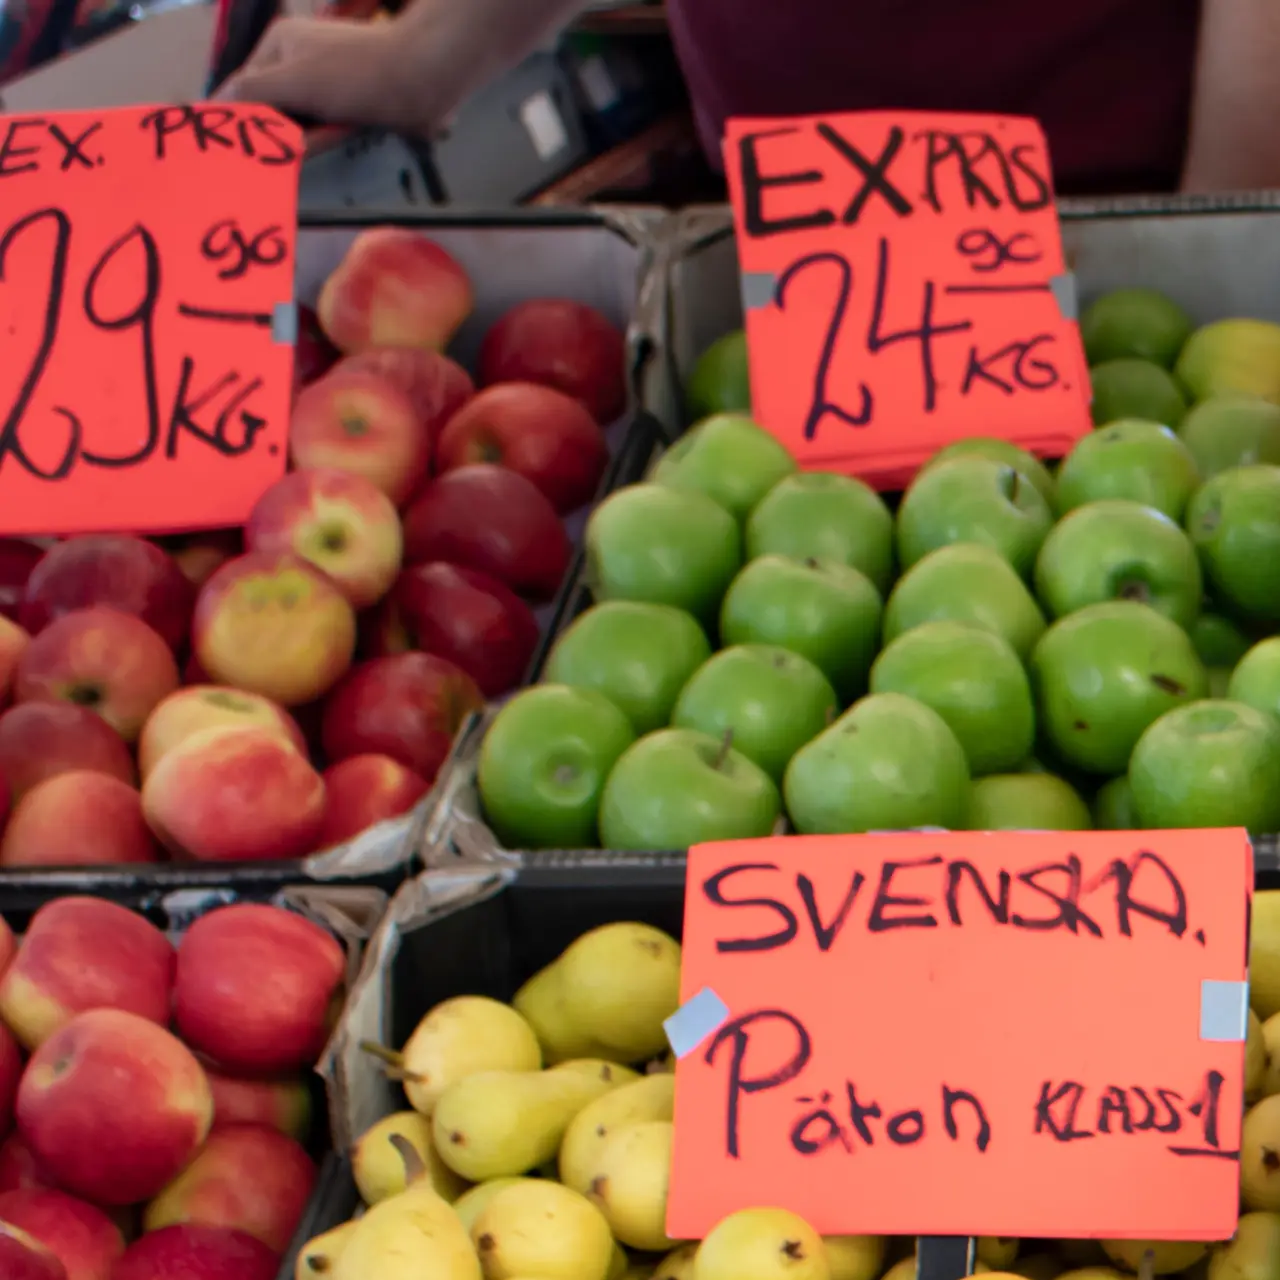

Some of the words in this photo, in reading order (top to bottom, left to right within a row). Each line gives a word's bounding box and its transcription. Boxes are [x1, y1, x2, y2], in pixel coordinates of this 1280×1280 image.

[0, 118, 105, 178] EX.
[140, 105, 299, 165] PRIS
[739, 122, 914, 238] EX
[912, 129, 1051, 214] PRIS
[200, 219, 288, 281] 90
[0, 207, 162, 482] 29
[774, 237, 973, 441] 24
[166, 355, 279, 460] KG.
